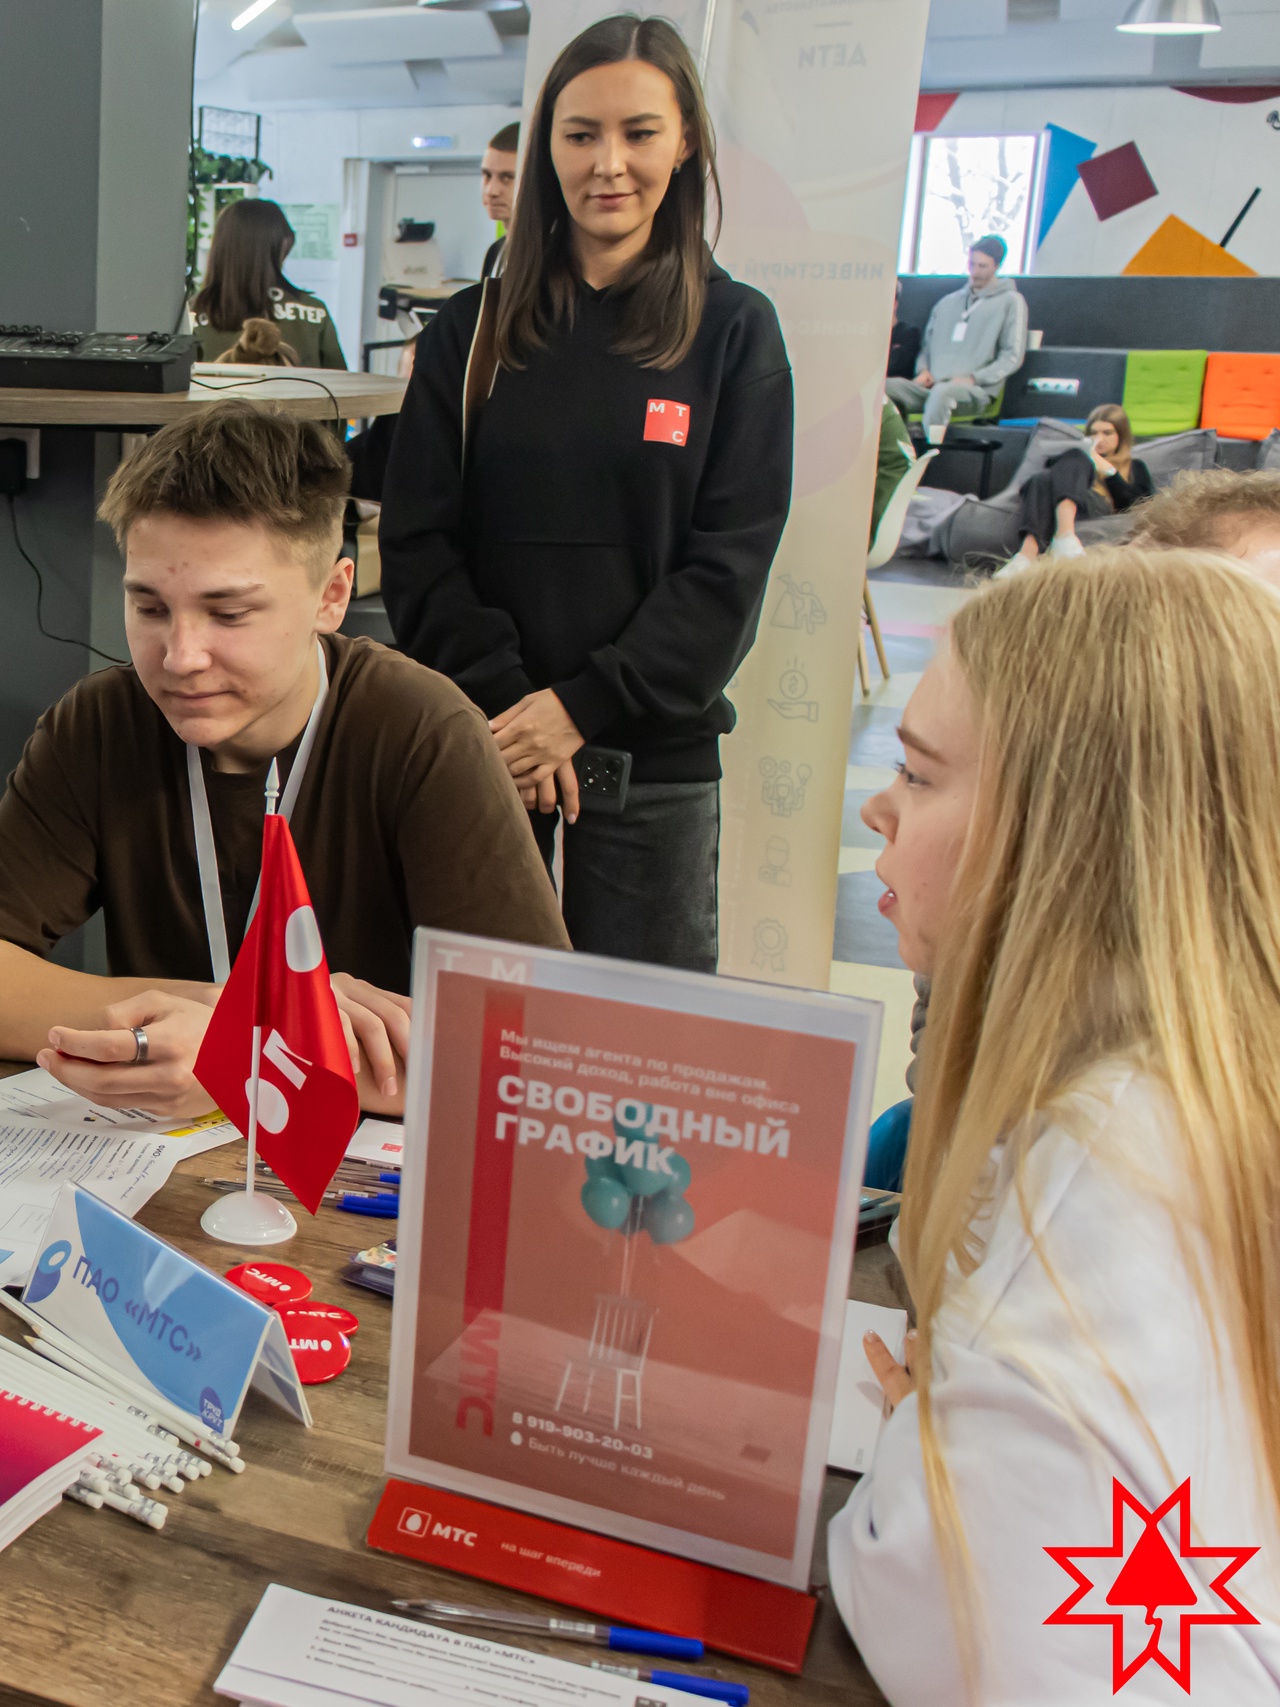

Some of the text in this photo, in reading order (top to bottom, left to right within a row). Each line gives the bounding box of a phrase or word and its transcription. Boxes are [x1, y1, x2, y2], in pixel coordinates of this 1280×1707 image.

[501, 1029, 528, 1046] Мы
[533, 1039, 580, 1055] ищем
[585, 1047, 642, 1068] агента
[647, 1058, 668, 1072] по
[499, 1046, 573, 1071] Высокий
[638, 1075, 701, 1096] работа
[705, 1087, 737, 1102] вне
[741, 1093, 800, 1115] офиса
[495, 1112, 676, 1176] ГРАФИК
[497, 1075, 791, 1158] СВОБОДНЫЙ
[245, 1268, 283, 1288] МТС
[73, 1255, 202, 1362] ПАО «МТС»
[289, 1338, 319, 1351] МТ
[456, 1316, 500, 1437] МТС
[529, 1437, 725, 1500] Быть лучше каждый день
[432, 1522, 478, 1548] МТС
[501, 1542, 601, 1577] на шаг впереди
[327, 1606, 373, 1623] АНКЕТА
[376, 1618, 450, 1643] КАНДИДАТА
[464, 1640, 491, 1653] ПАО
